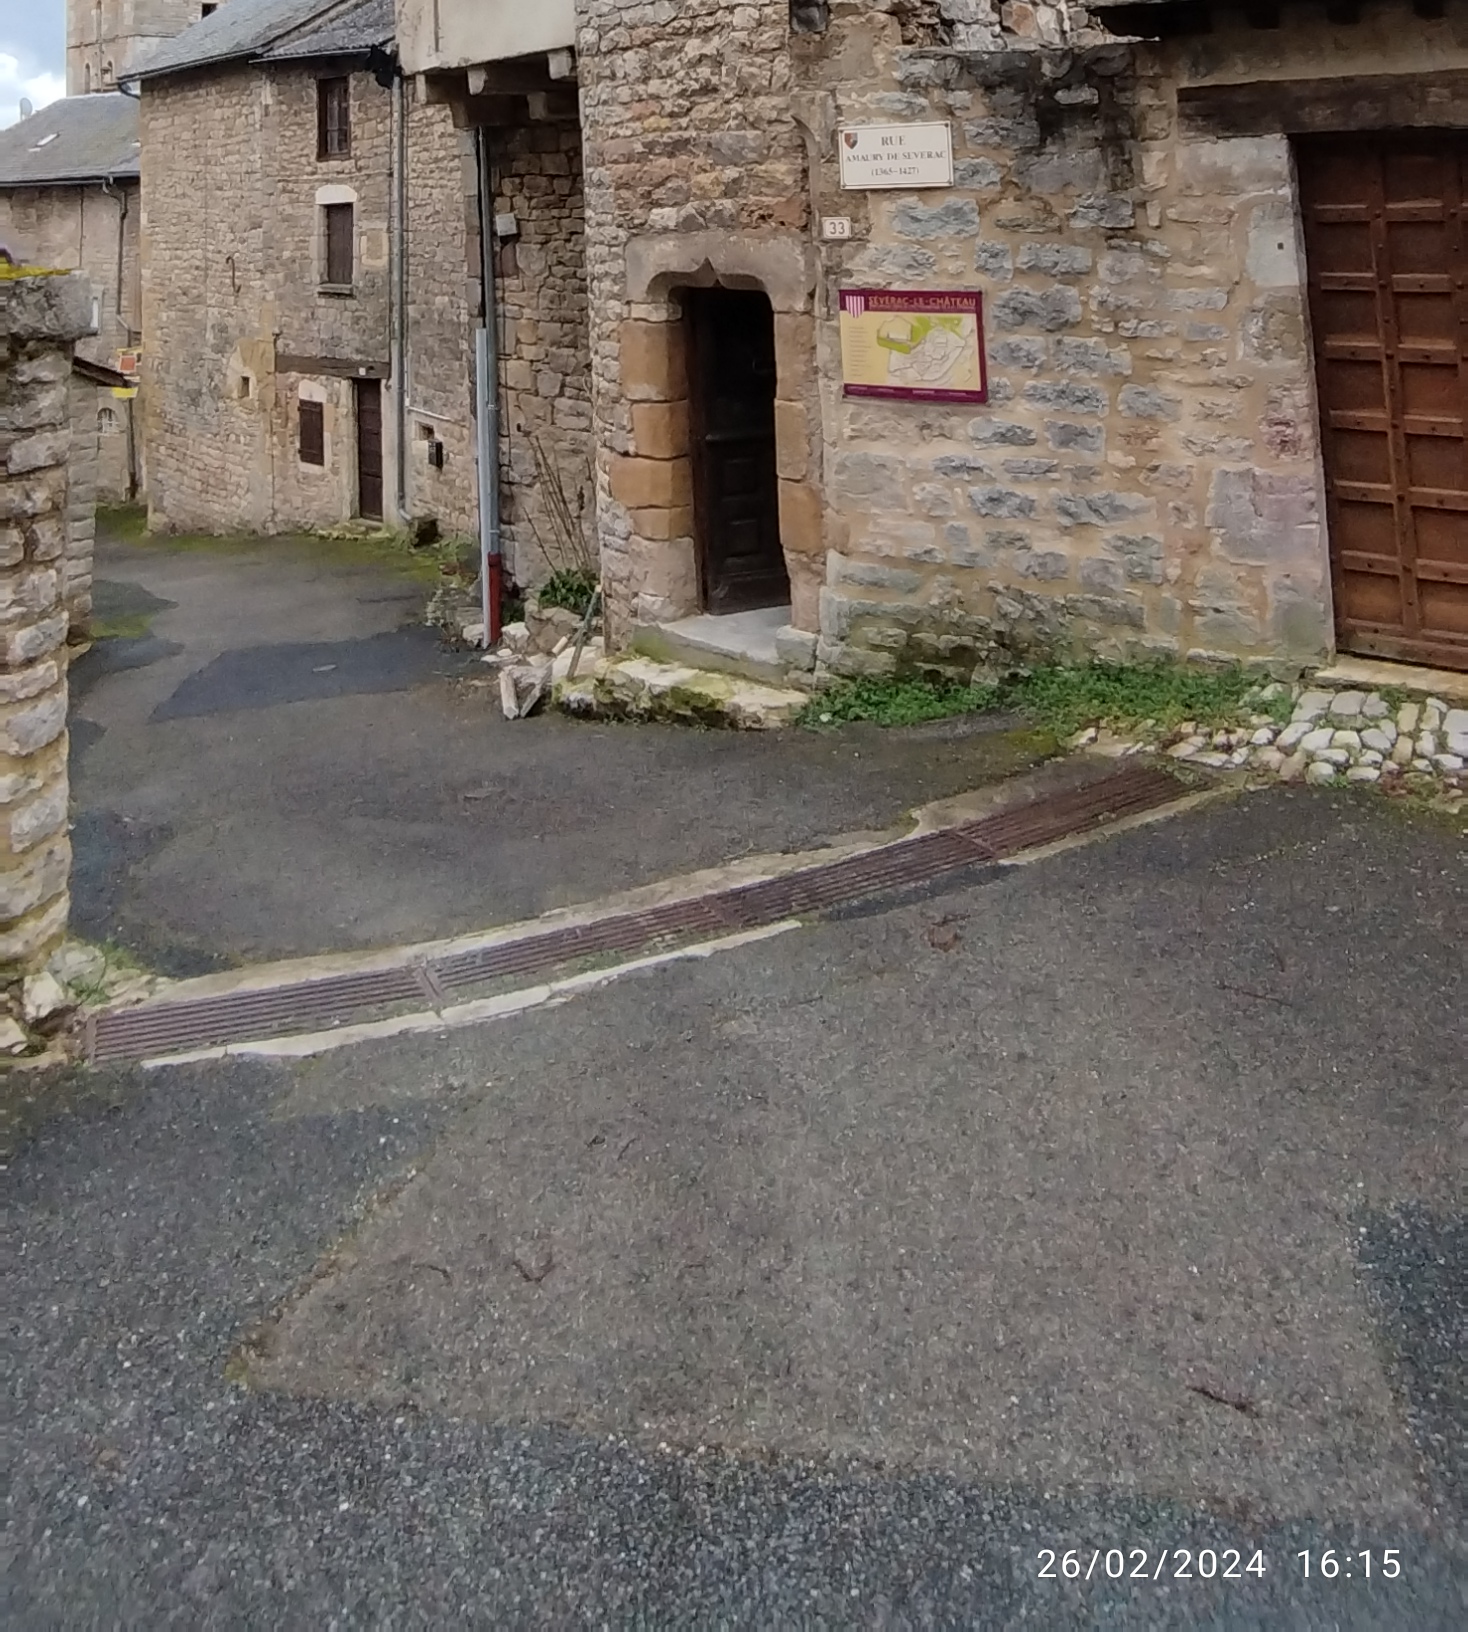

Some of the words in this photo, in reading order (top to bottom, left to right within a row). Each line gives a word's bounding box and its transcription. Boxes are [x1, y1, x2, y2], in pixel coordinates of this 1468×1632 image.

[881, 135, 906, 146] RUE
[845, 153, 884, 162] AMAURY
[887, 152, 900, 161] DE
[829, 222, 846, 235] 33
